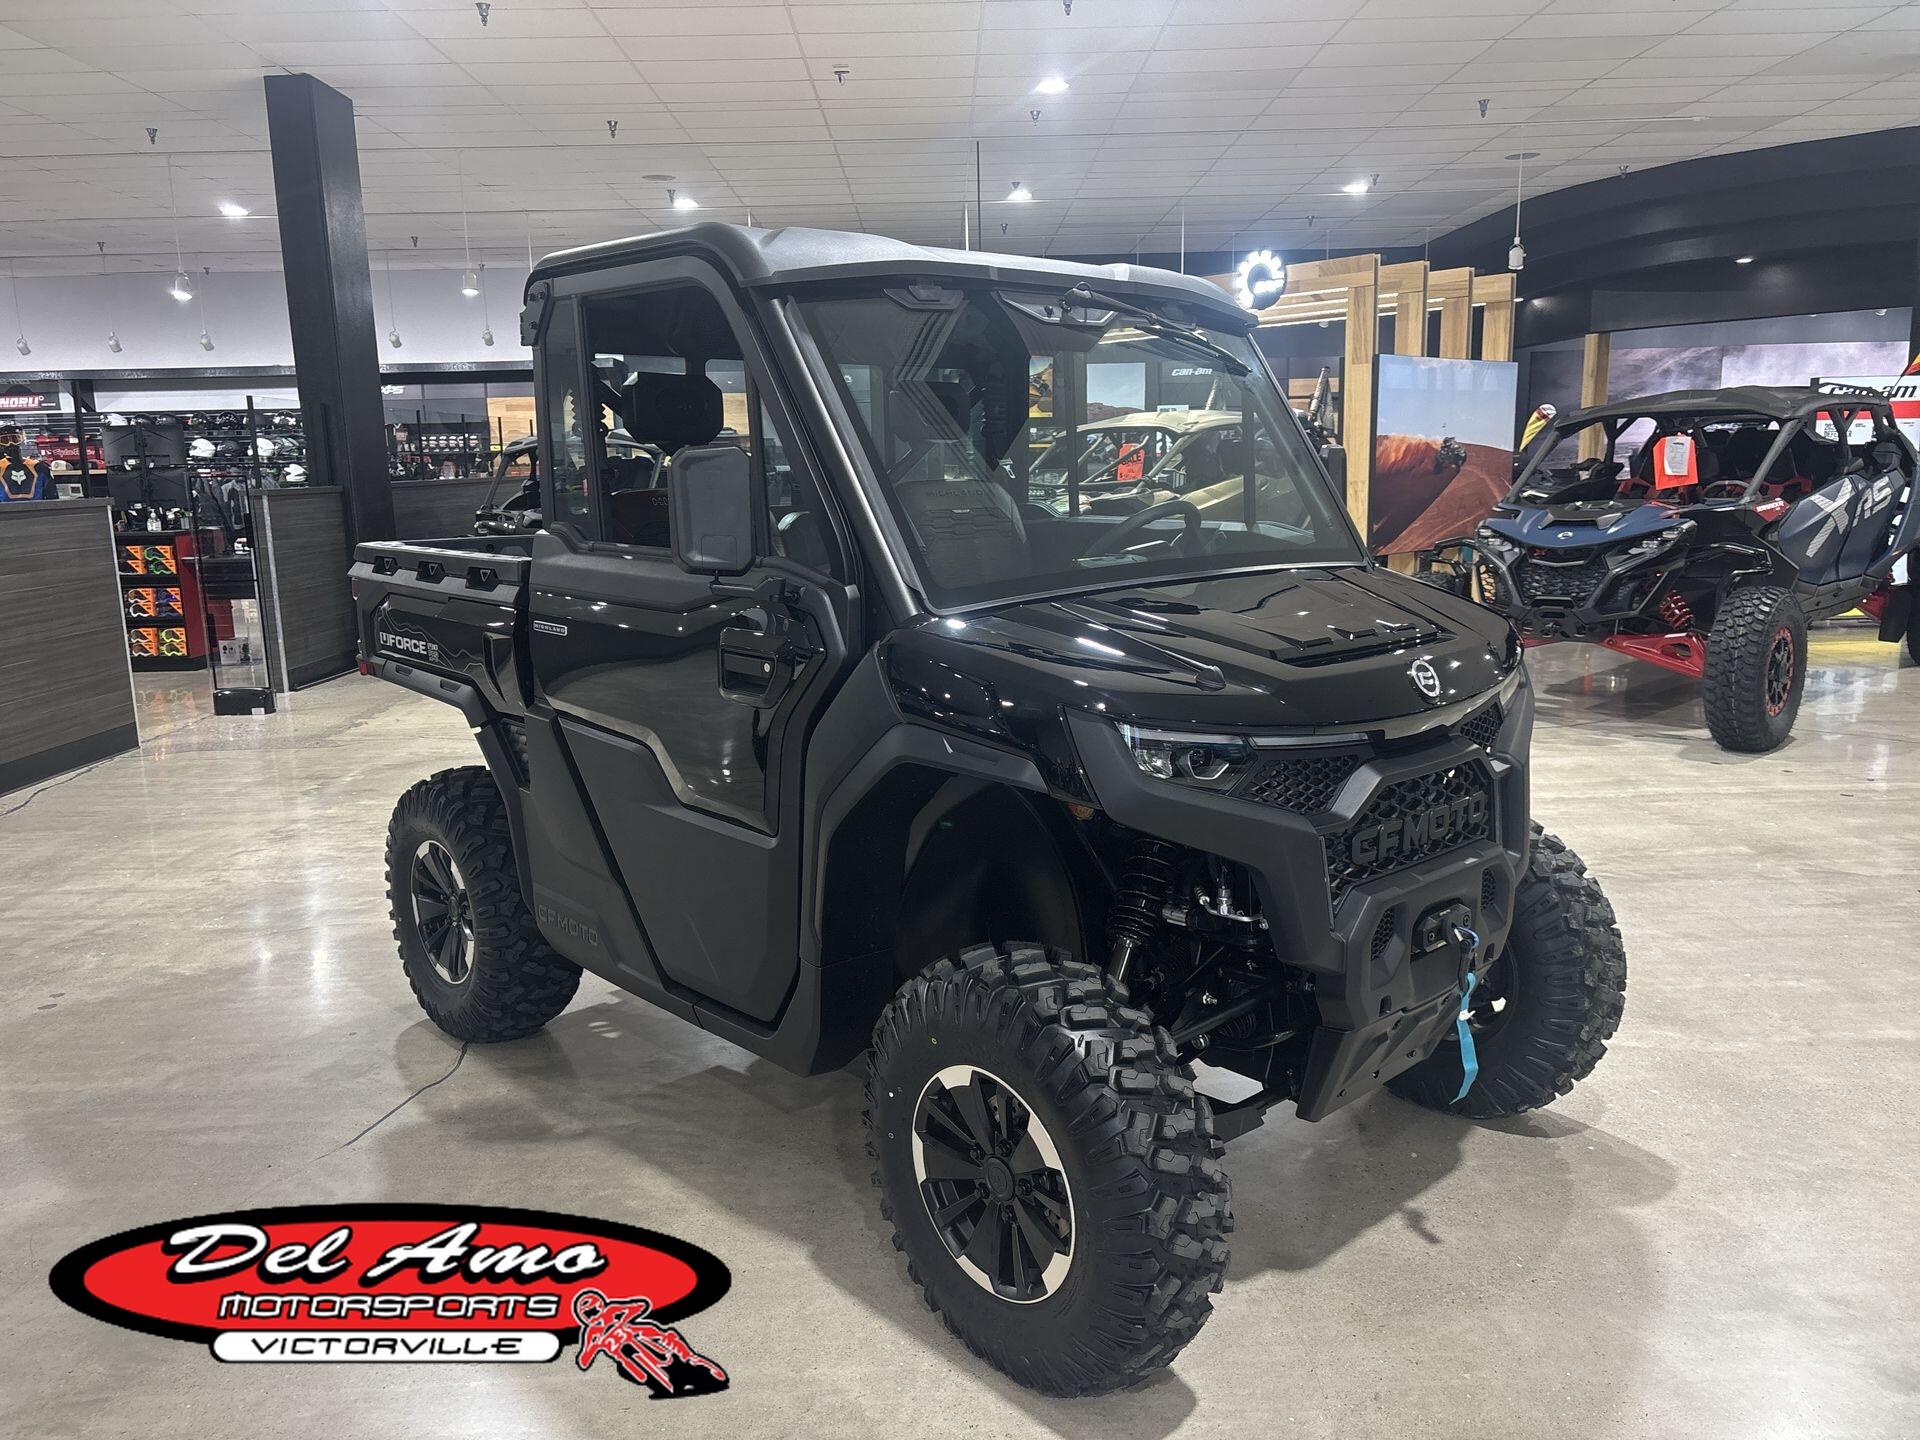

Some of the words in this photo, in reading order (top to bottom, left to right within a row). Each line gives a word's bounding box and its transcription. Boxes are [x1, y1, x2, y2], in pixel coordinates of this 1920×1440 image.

[1171, 367, 1213, 377] can-am
[534, 623, 566, 634] HIGHLAND
[1351, 790, 1488, 866] CFMOTO
[538, 904, 598, 947] CFMOTO
